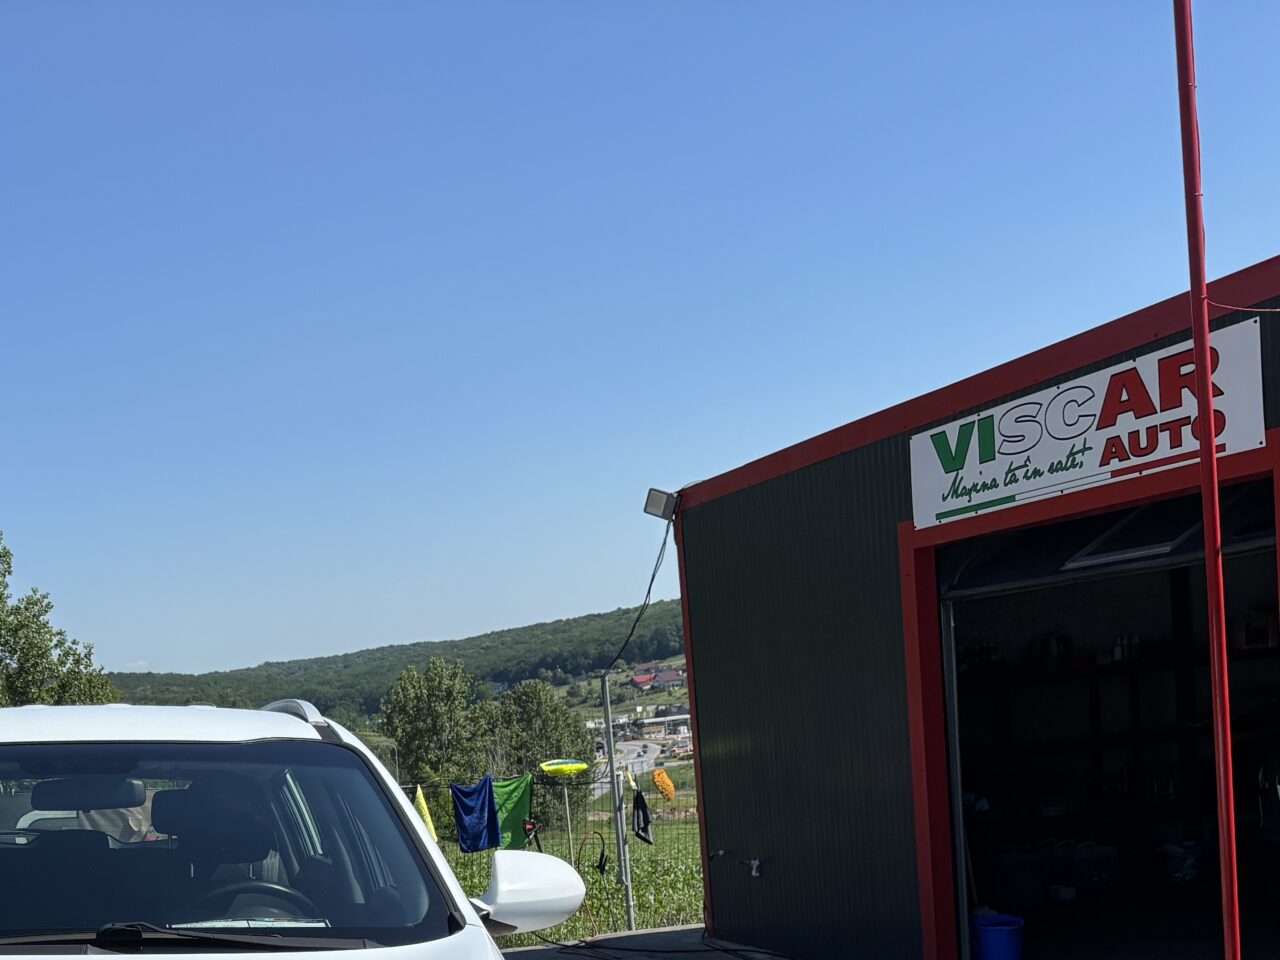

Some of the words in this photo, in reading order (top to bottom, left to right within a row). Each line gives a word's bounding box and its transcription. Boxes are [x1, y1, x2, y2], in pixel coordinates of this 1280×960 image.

[930, 346, 1225, 474] VISCAR
[1098, 408, 1227, 467] AUTO
[1003, 460, 1029, 487] ta
